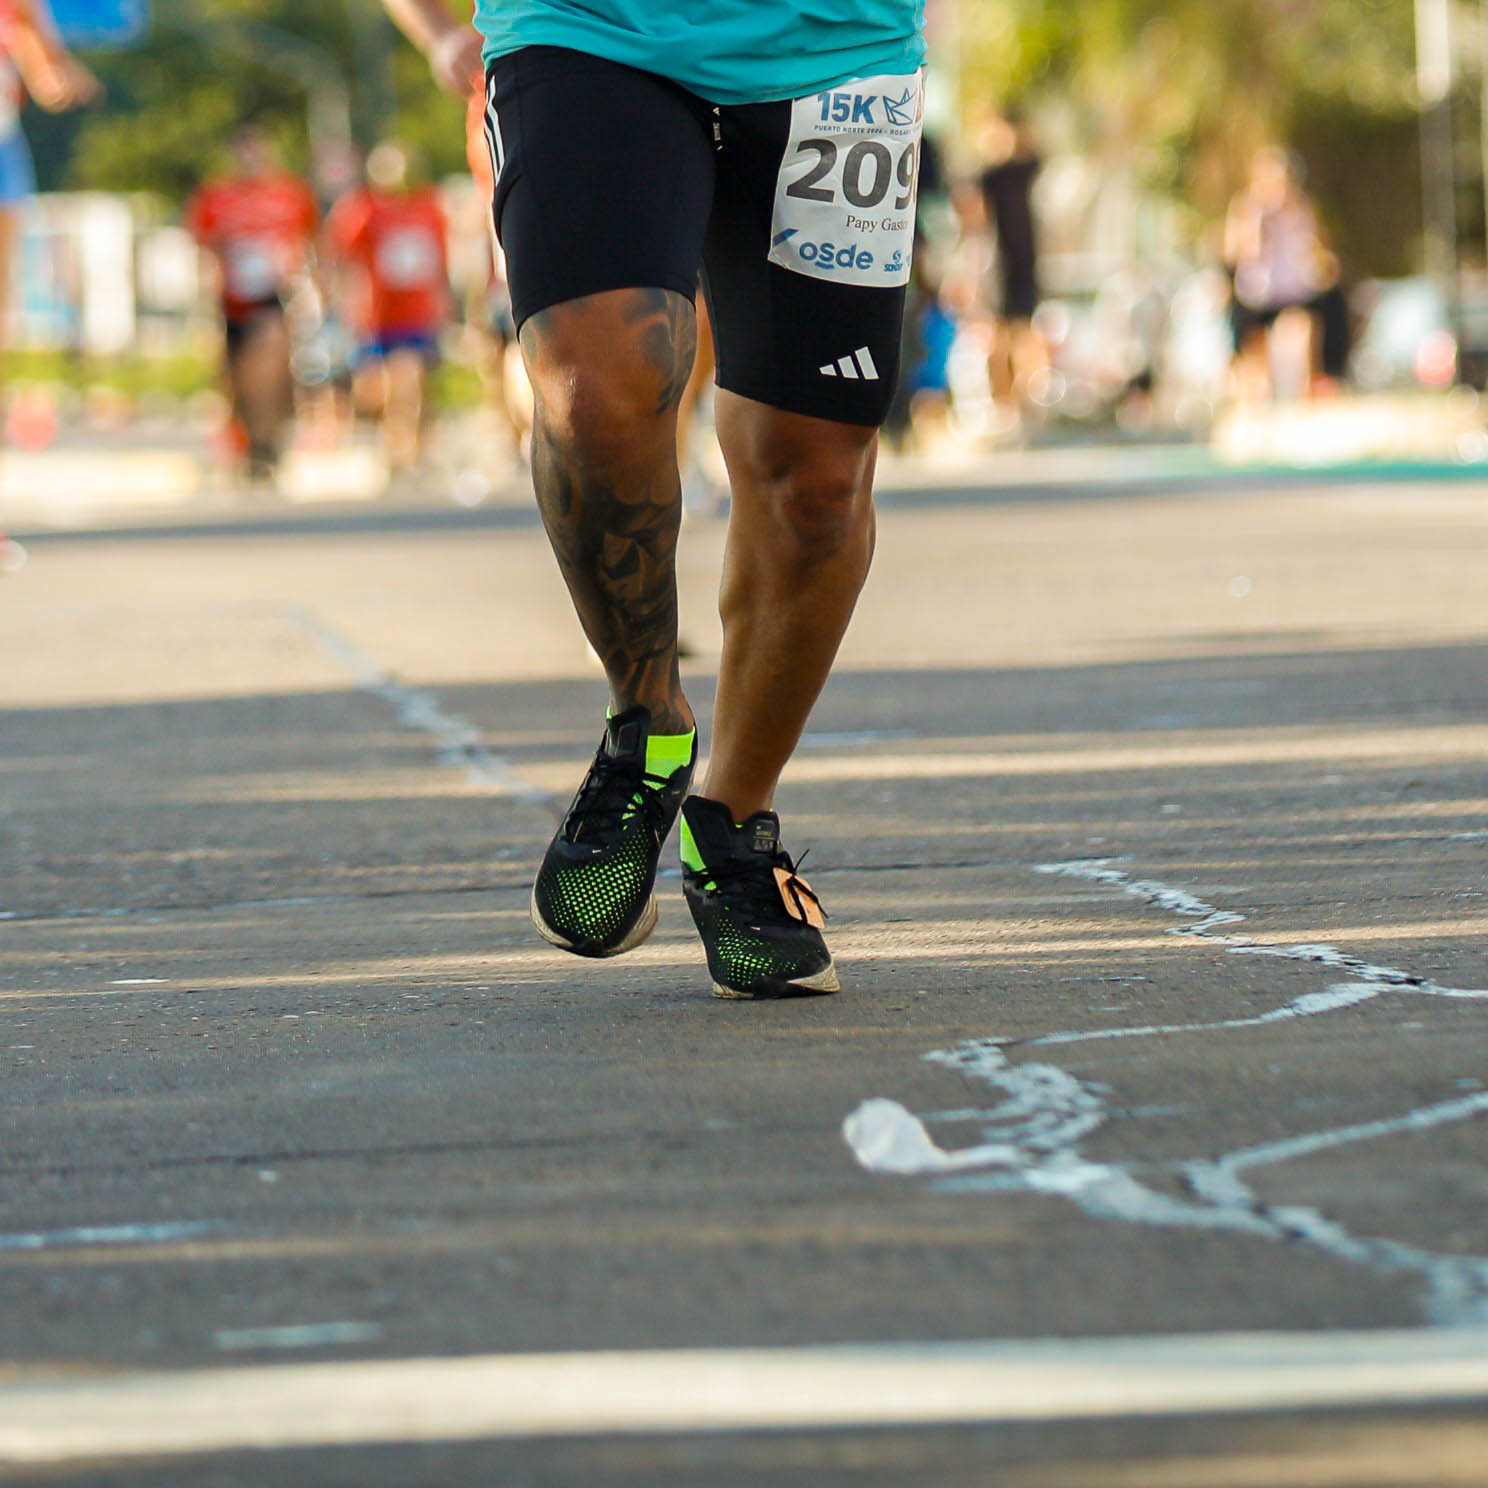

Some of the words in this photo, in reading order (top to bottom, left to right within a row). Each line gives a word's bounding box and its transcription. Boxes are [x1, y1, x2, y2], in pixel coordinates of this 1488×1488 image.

[817, 93, 878, 124] 15K
[814, 125, 841, 133] PUERTO
[843, 126, 865, 134] NORTE
[846, 215, 878, 233] Papy
[799, 241, 874, 270] osde
